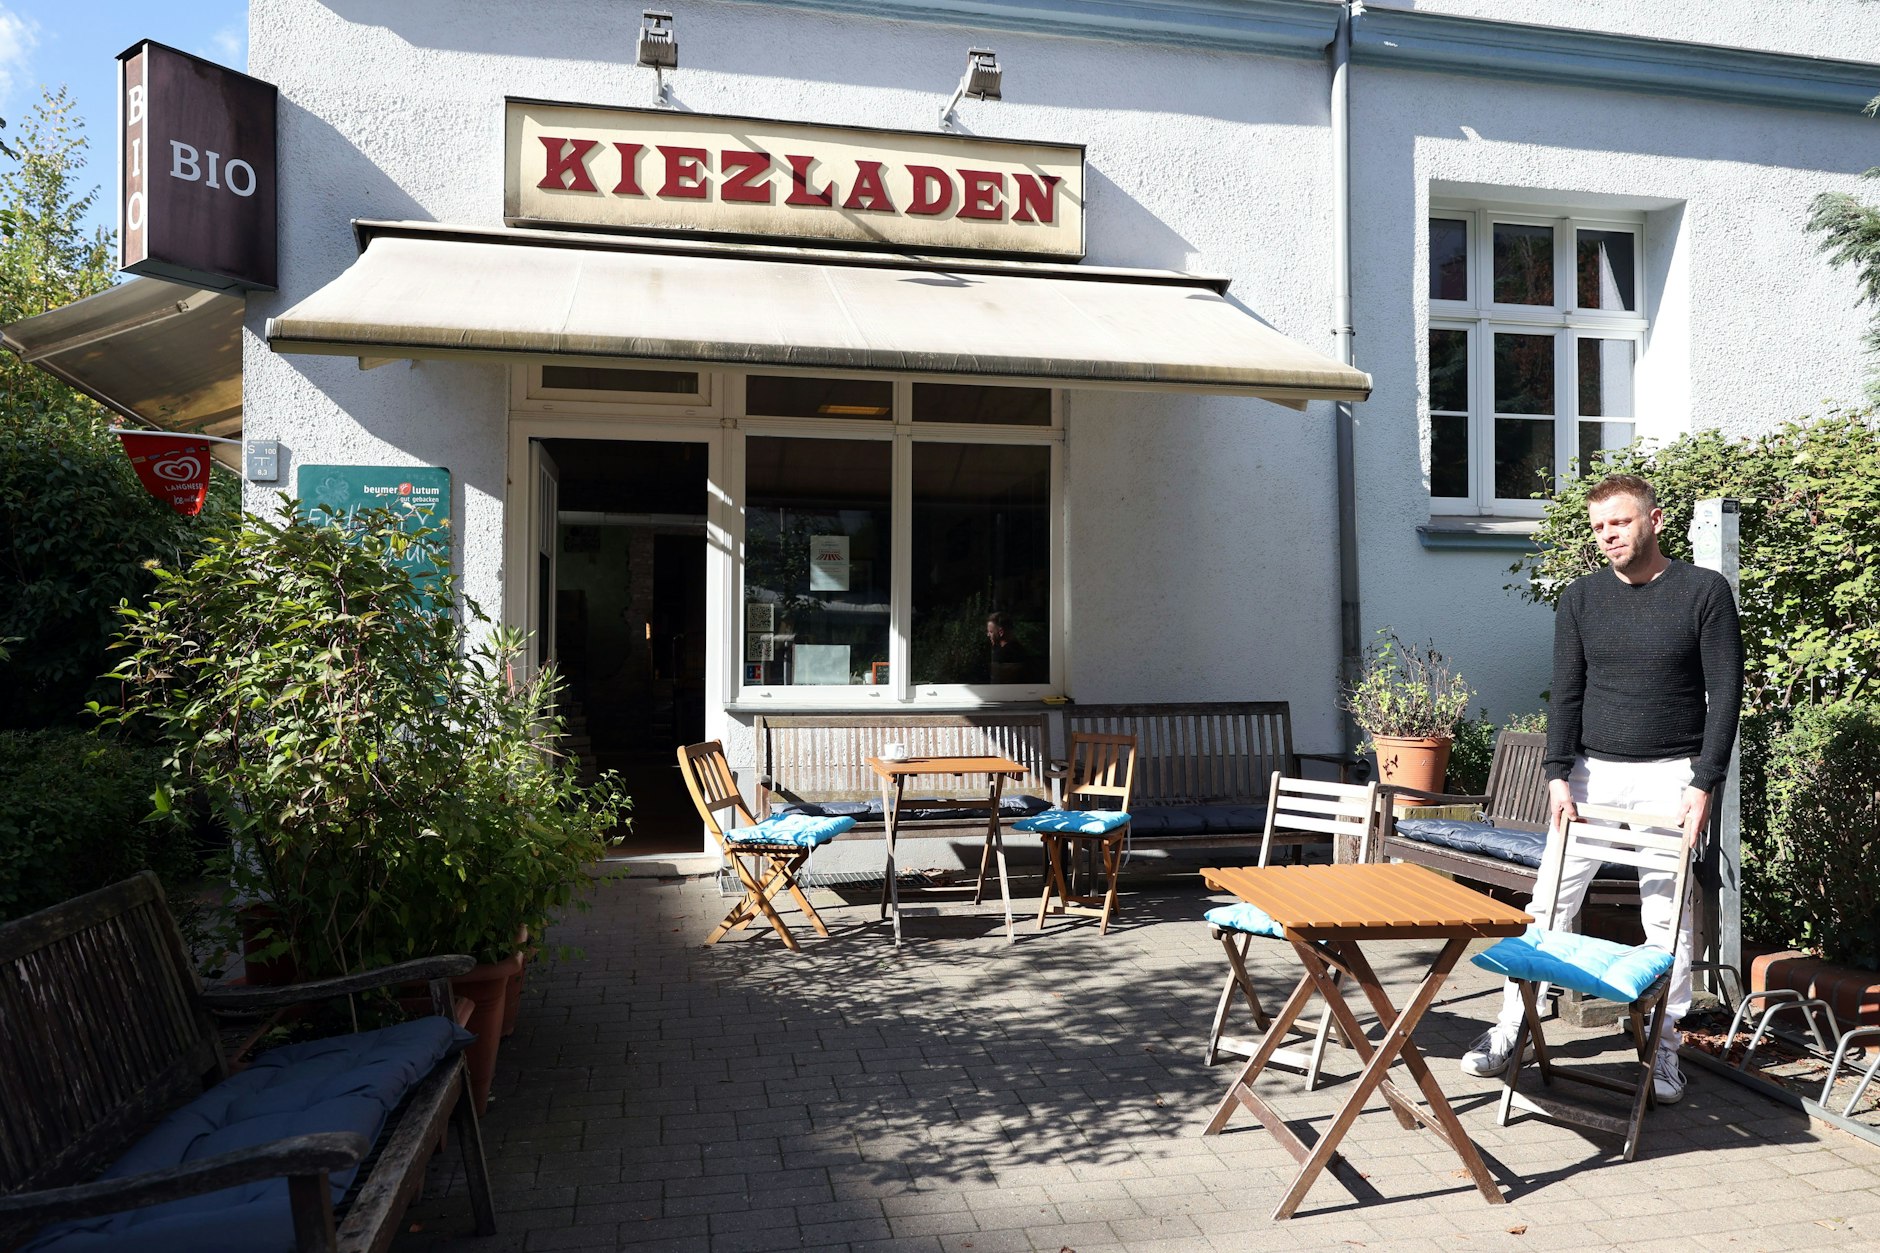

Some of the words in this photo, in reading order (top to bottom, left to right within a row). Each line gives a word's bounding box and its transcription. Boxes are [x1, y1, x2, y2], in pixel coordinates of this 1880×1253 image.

[128, 84, 143, 231] BIO
[169, 139, 257, 197] BIO
[537, 135, 1062, 224] KIEZLADEN
[247, 444, 256, 455] S
[363, 485, 399, 494] beumer
[412, 486, 440, 495] lutum
